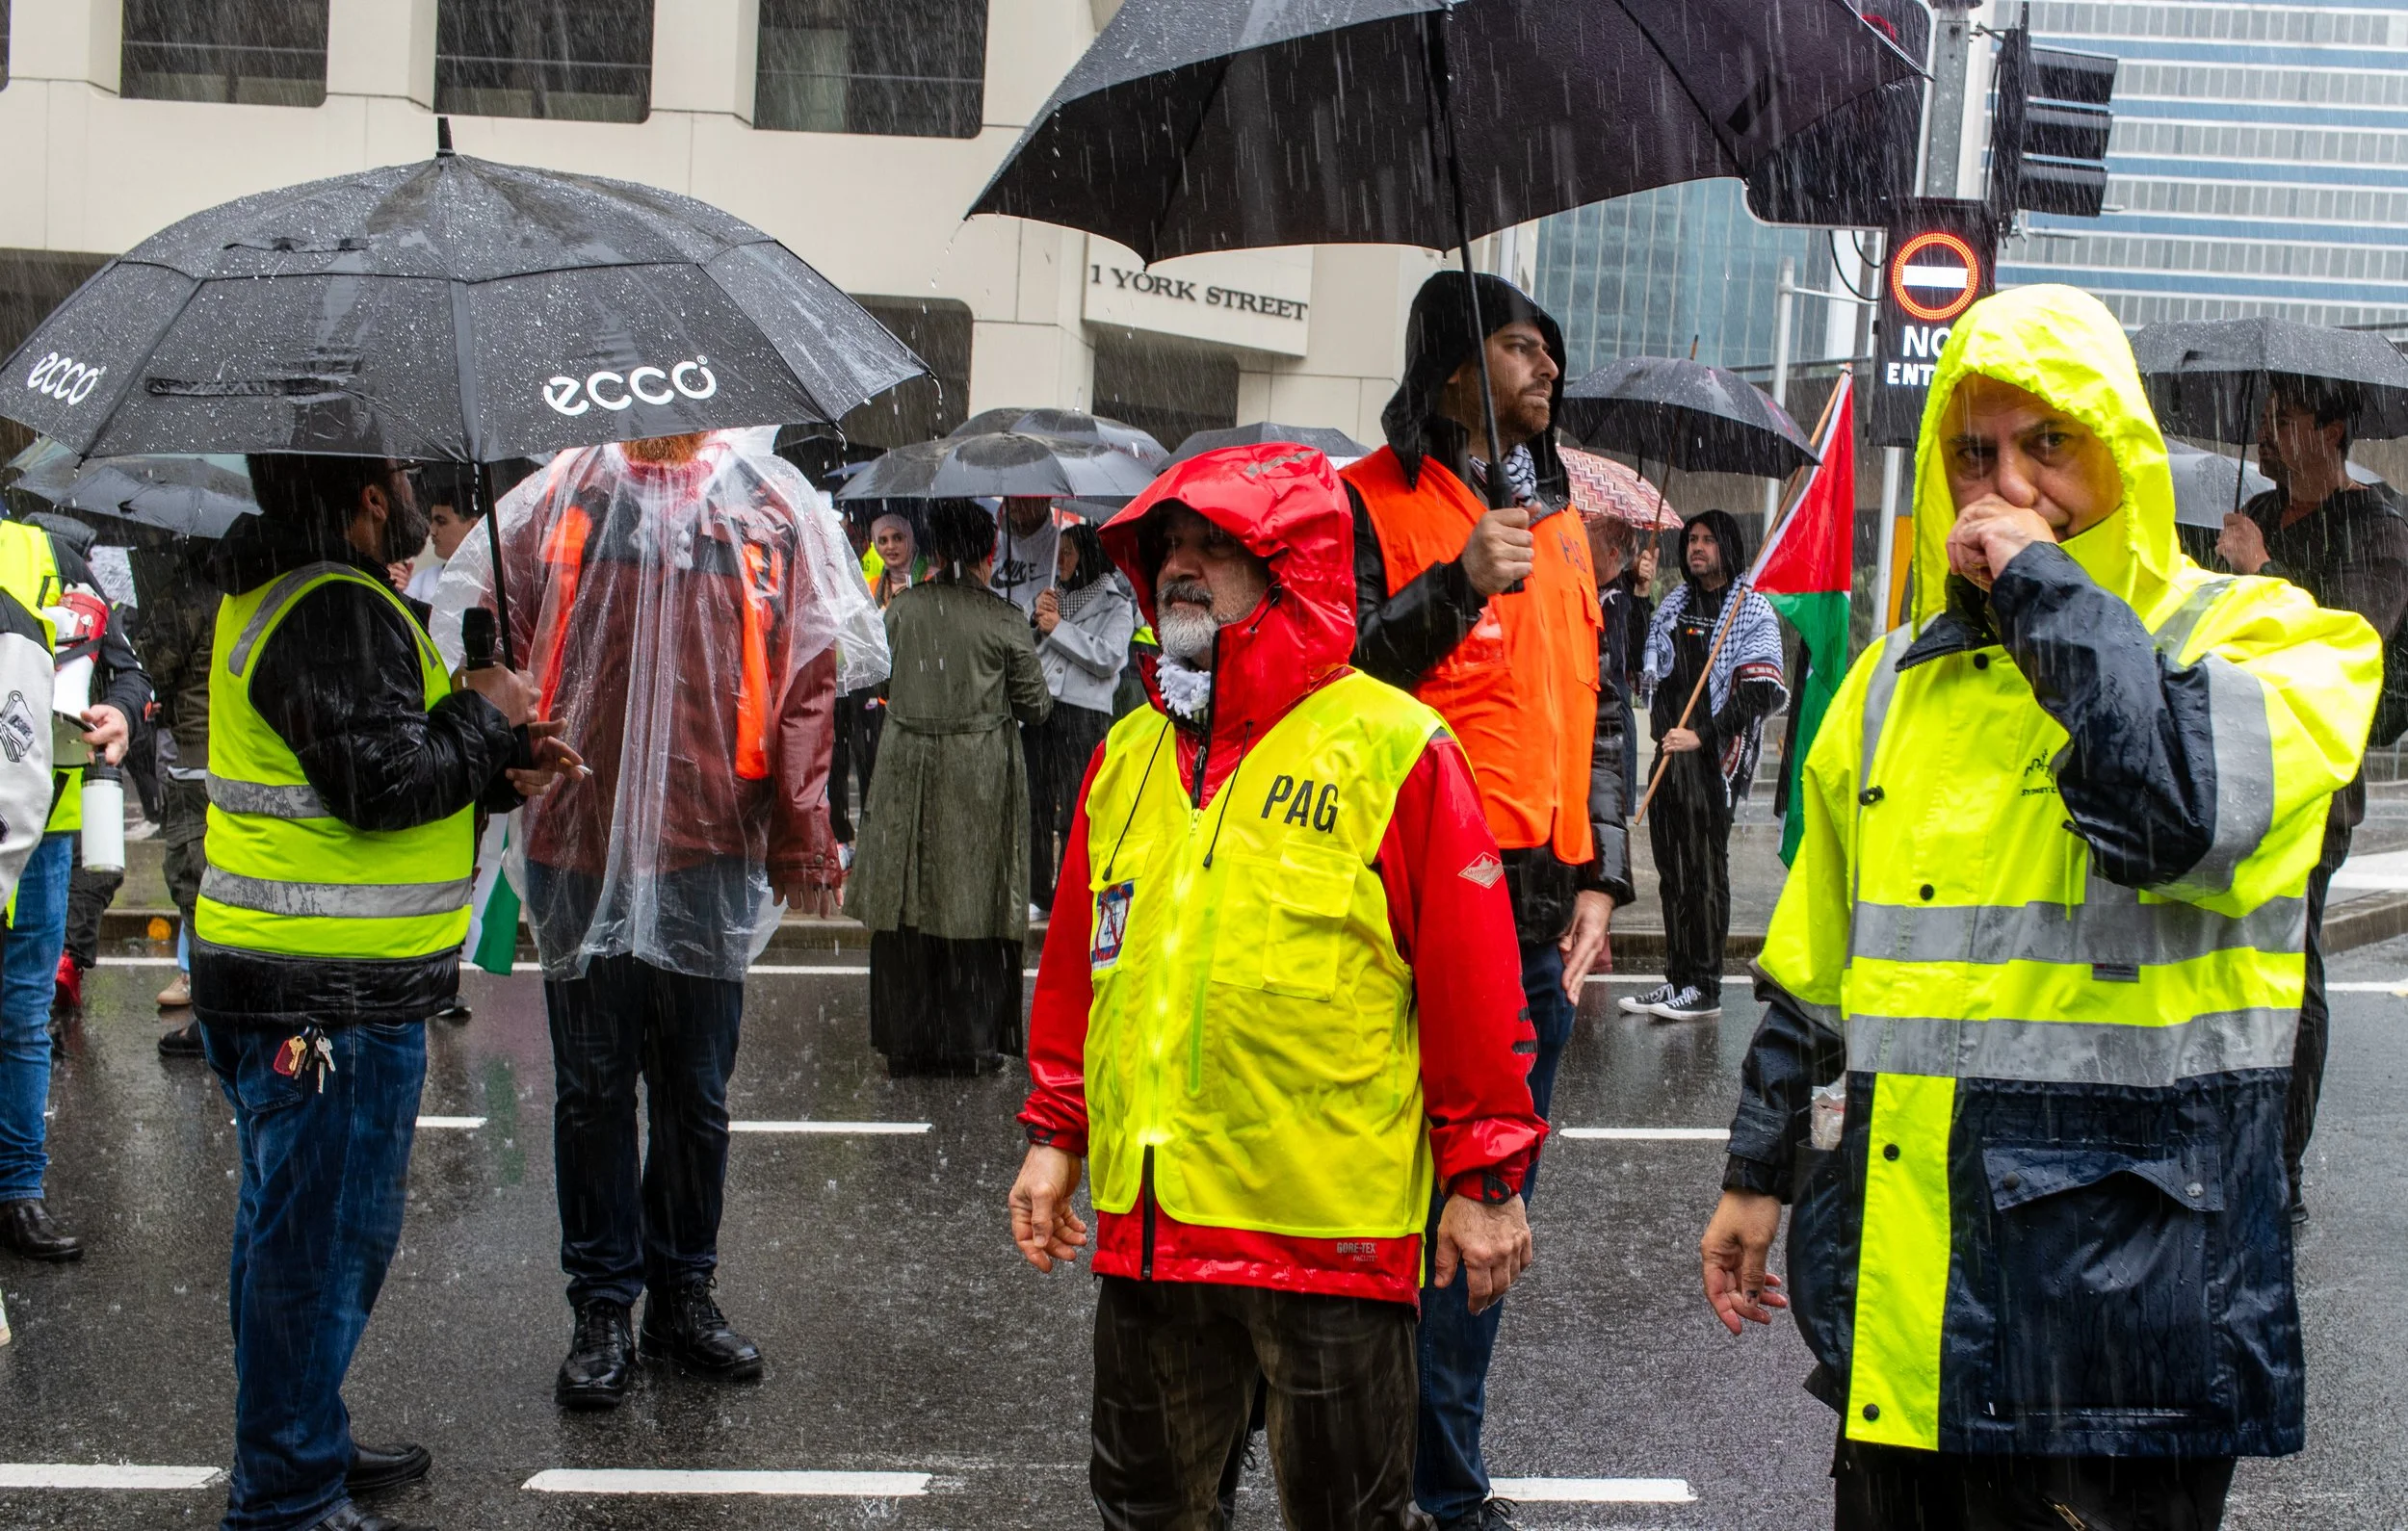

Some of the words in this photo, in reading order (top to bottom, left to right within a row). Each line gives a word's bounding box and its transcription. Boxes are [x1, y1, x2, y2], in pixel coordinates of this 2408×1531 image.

[1090, 264, 1102, 285] 1
[1111, 267, 1197, 302] YORK
[1205, 286, 1308, 322] STREET
[1902, 324, 1952, 358] NO
[1886, 362, 1935, 386] ENT
[1260, 774, 1339, 835] PAG
[1336, 1241, 1376, 1255] GORE-TEX
